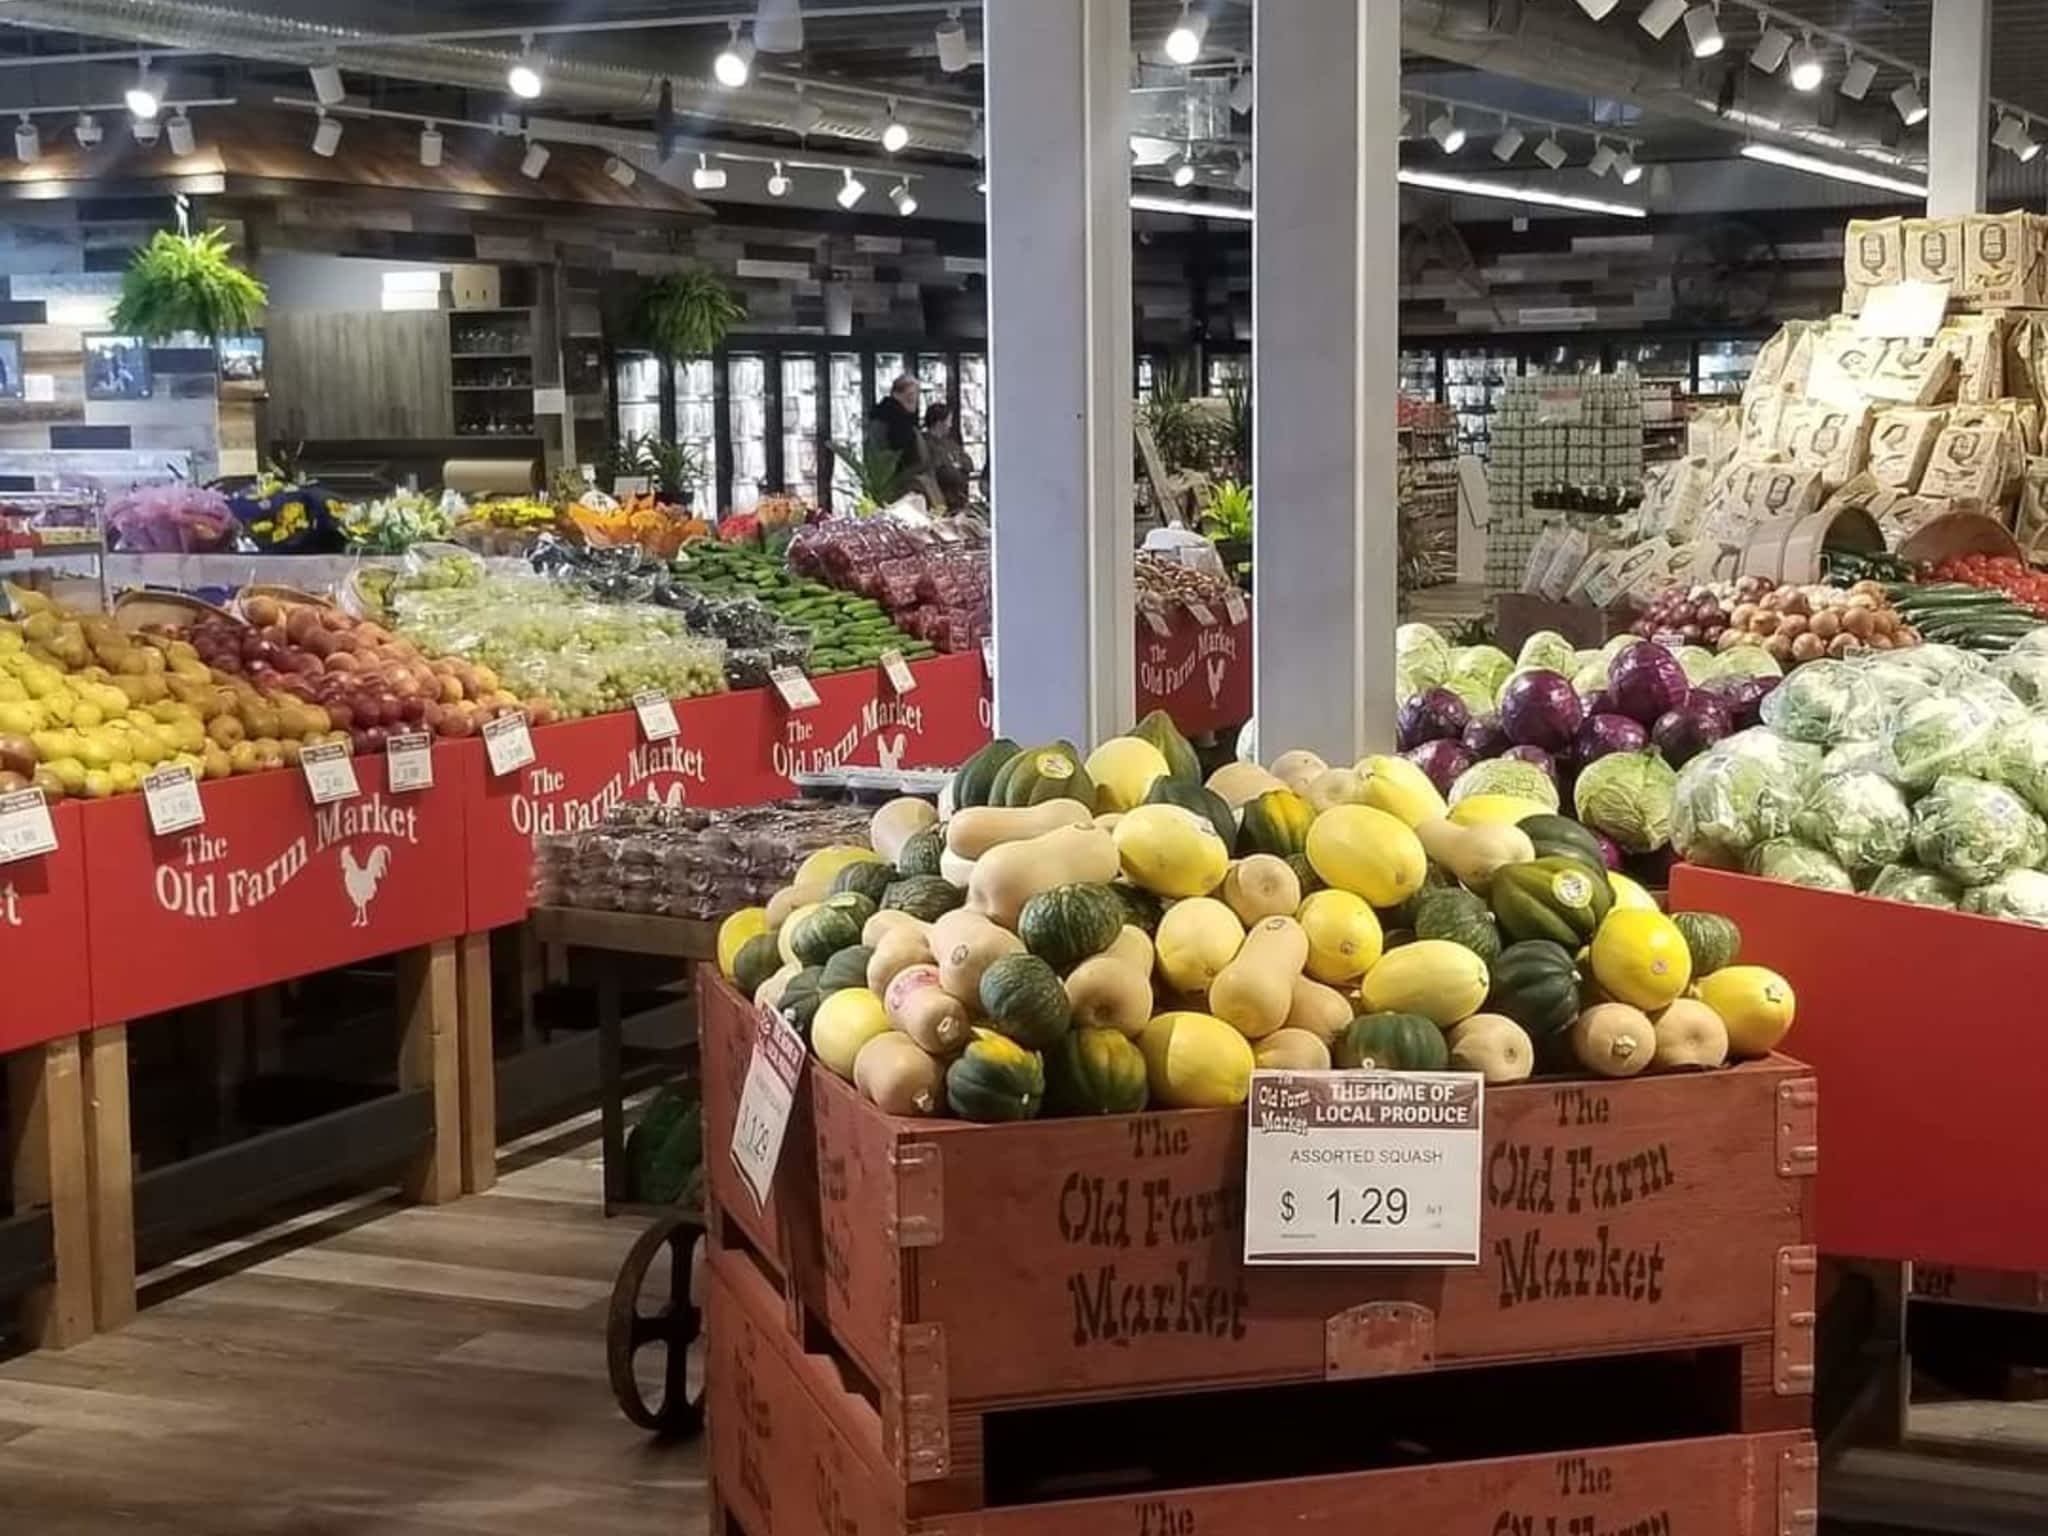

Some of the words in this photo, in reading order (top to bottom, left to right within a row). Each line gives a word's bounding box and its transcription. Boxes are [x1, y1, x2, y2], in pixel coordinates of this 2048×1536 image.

[786, 719, 813, 743] The
[813, 724, 858, 776] Farm
[861, 693, 923, 737] Market
[511, 793, 554, 836] Old
[563, 772, 623, 833] Farm
[628, 737, 706, 787] Market
[530, 767, 565, 796] The
[156, 865, 217, 919] Old
[228, 836, 307, 915] Farm
[316, 792, 418, 852] Market
[182, 833, 228, 867] The
[1259, 1086, 1278, 1108] Old
[1280, 1089, 1312, 1108] Farm
[1330, 1084, 1367, 1102] THE
[1371, 1084, 1427, 1102] HOME
[1430, 1084, 1456, 1102] OF
[1554, 1088, 1609, 1127] The
[1316, 1105, 1375, 1123] LOCAL
[1380, 1106, 1469, 1124] PRODUCE
[1128, 1118, 1191, 1159] The
[1290, 1149, 1375, 1164] ASSORTED
[1379, 1149, 1443, 1165] SQUASH
[1488, 1140, 1555, 1214] Old
[1565, 1144, 1675, 1213] Farm
[1058, 1171, 1131, 1248] Old
[1280, 1190, 1296, 1223] $
[1326, 1187, 1409, 1226] 1.29
[1495, 1226, 1665, 1309] Market
[1068, 1261, 1249, 1348] Market
[1556, 1457, 1613, 1497] The
[1134, 1500, 1196, 1536] The
